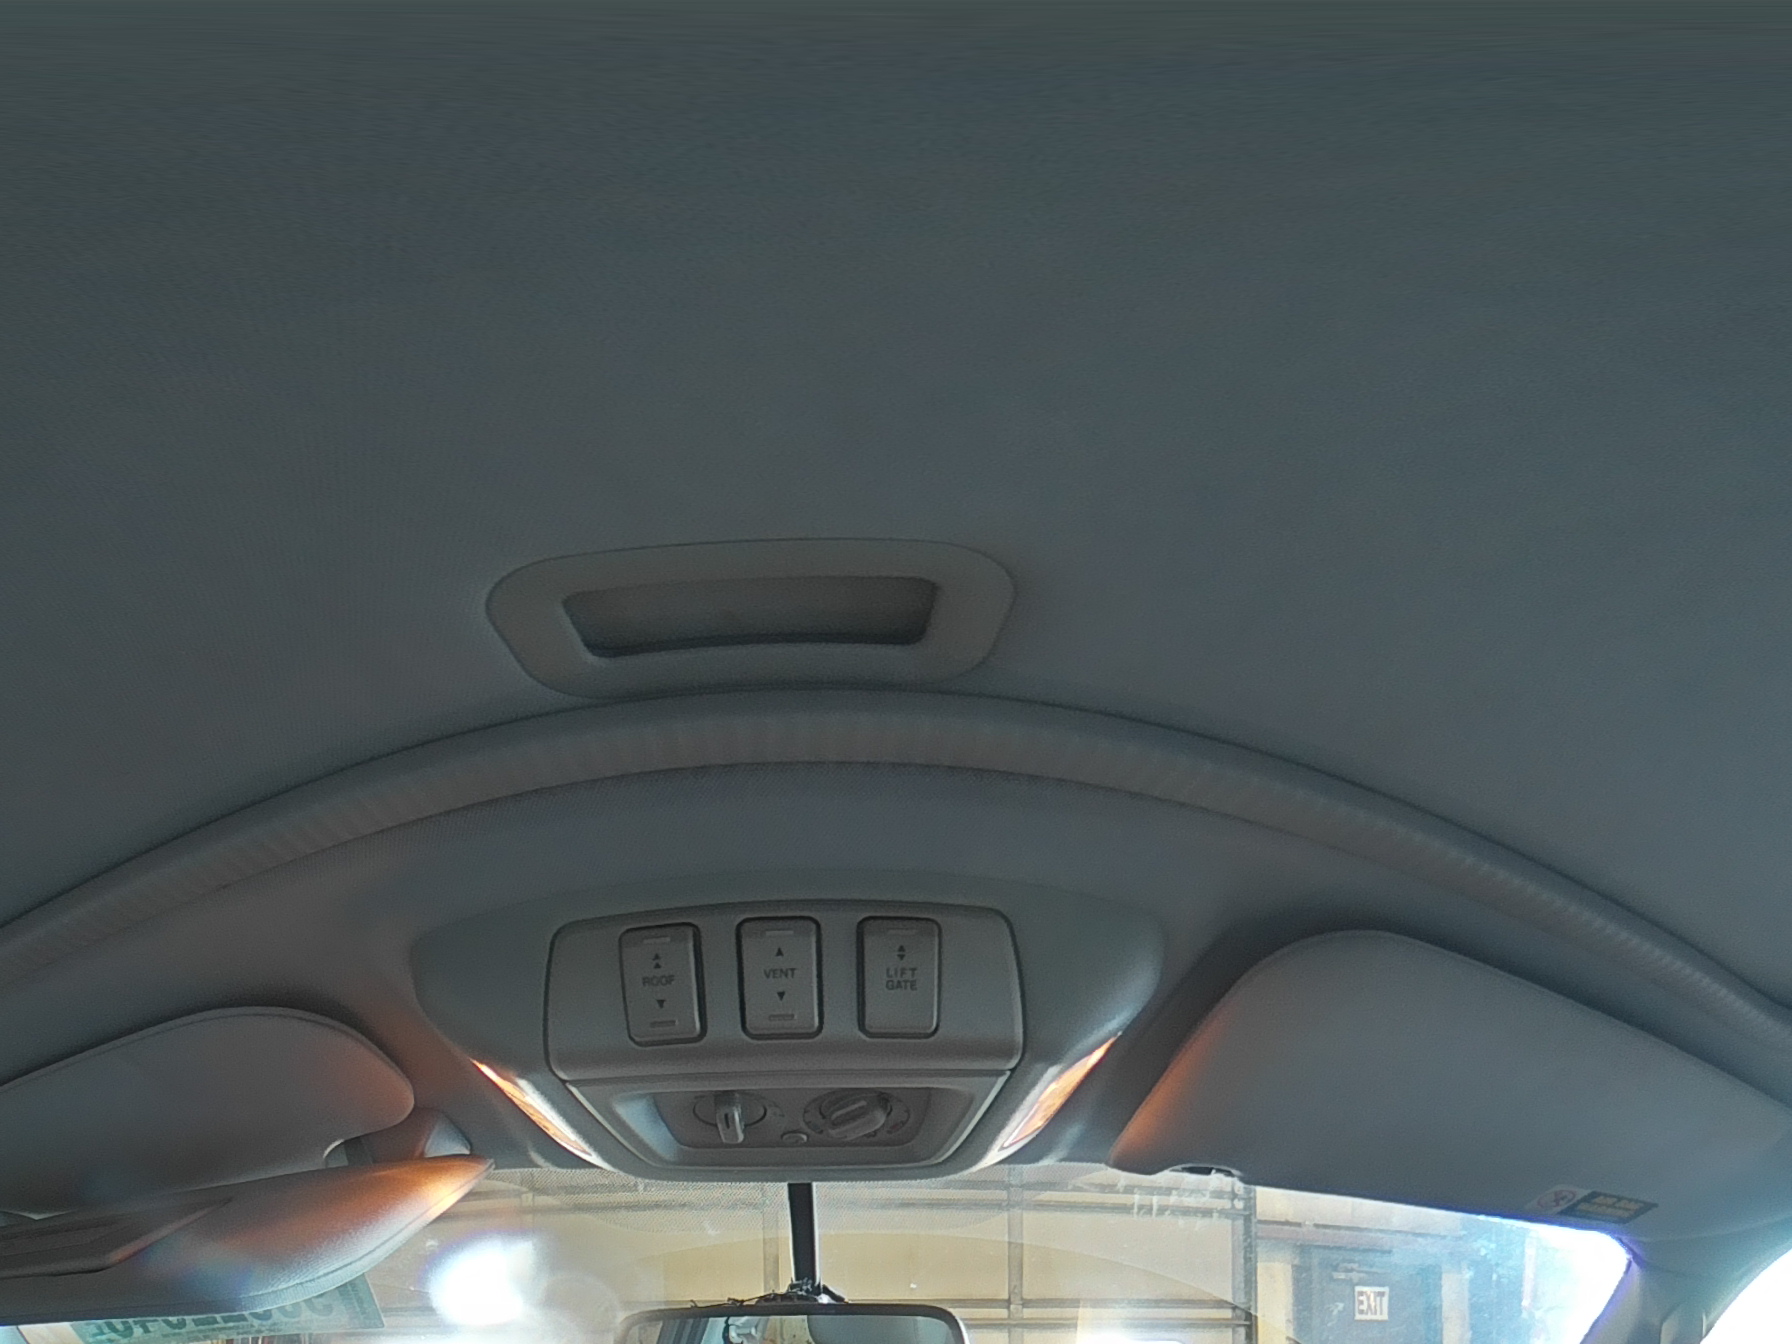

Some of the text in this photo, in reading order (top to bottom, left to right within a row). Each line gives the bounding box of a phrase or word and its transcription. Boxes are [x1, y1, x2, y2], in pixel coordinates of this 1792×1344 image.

[763, 967, 797, 979] VENT
[886, 967, 918, 979] LIFT
[641, 974, 676, 987] ROOF
[885, 979, 918, 991] GATE
[1356, 1290, 1386, 1316] EXIT
